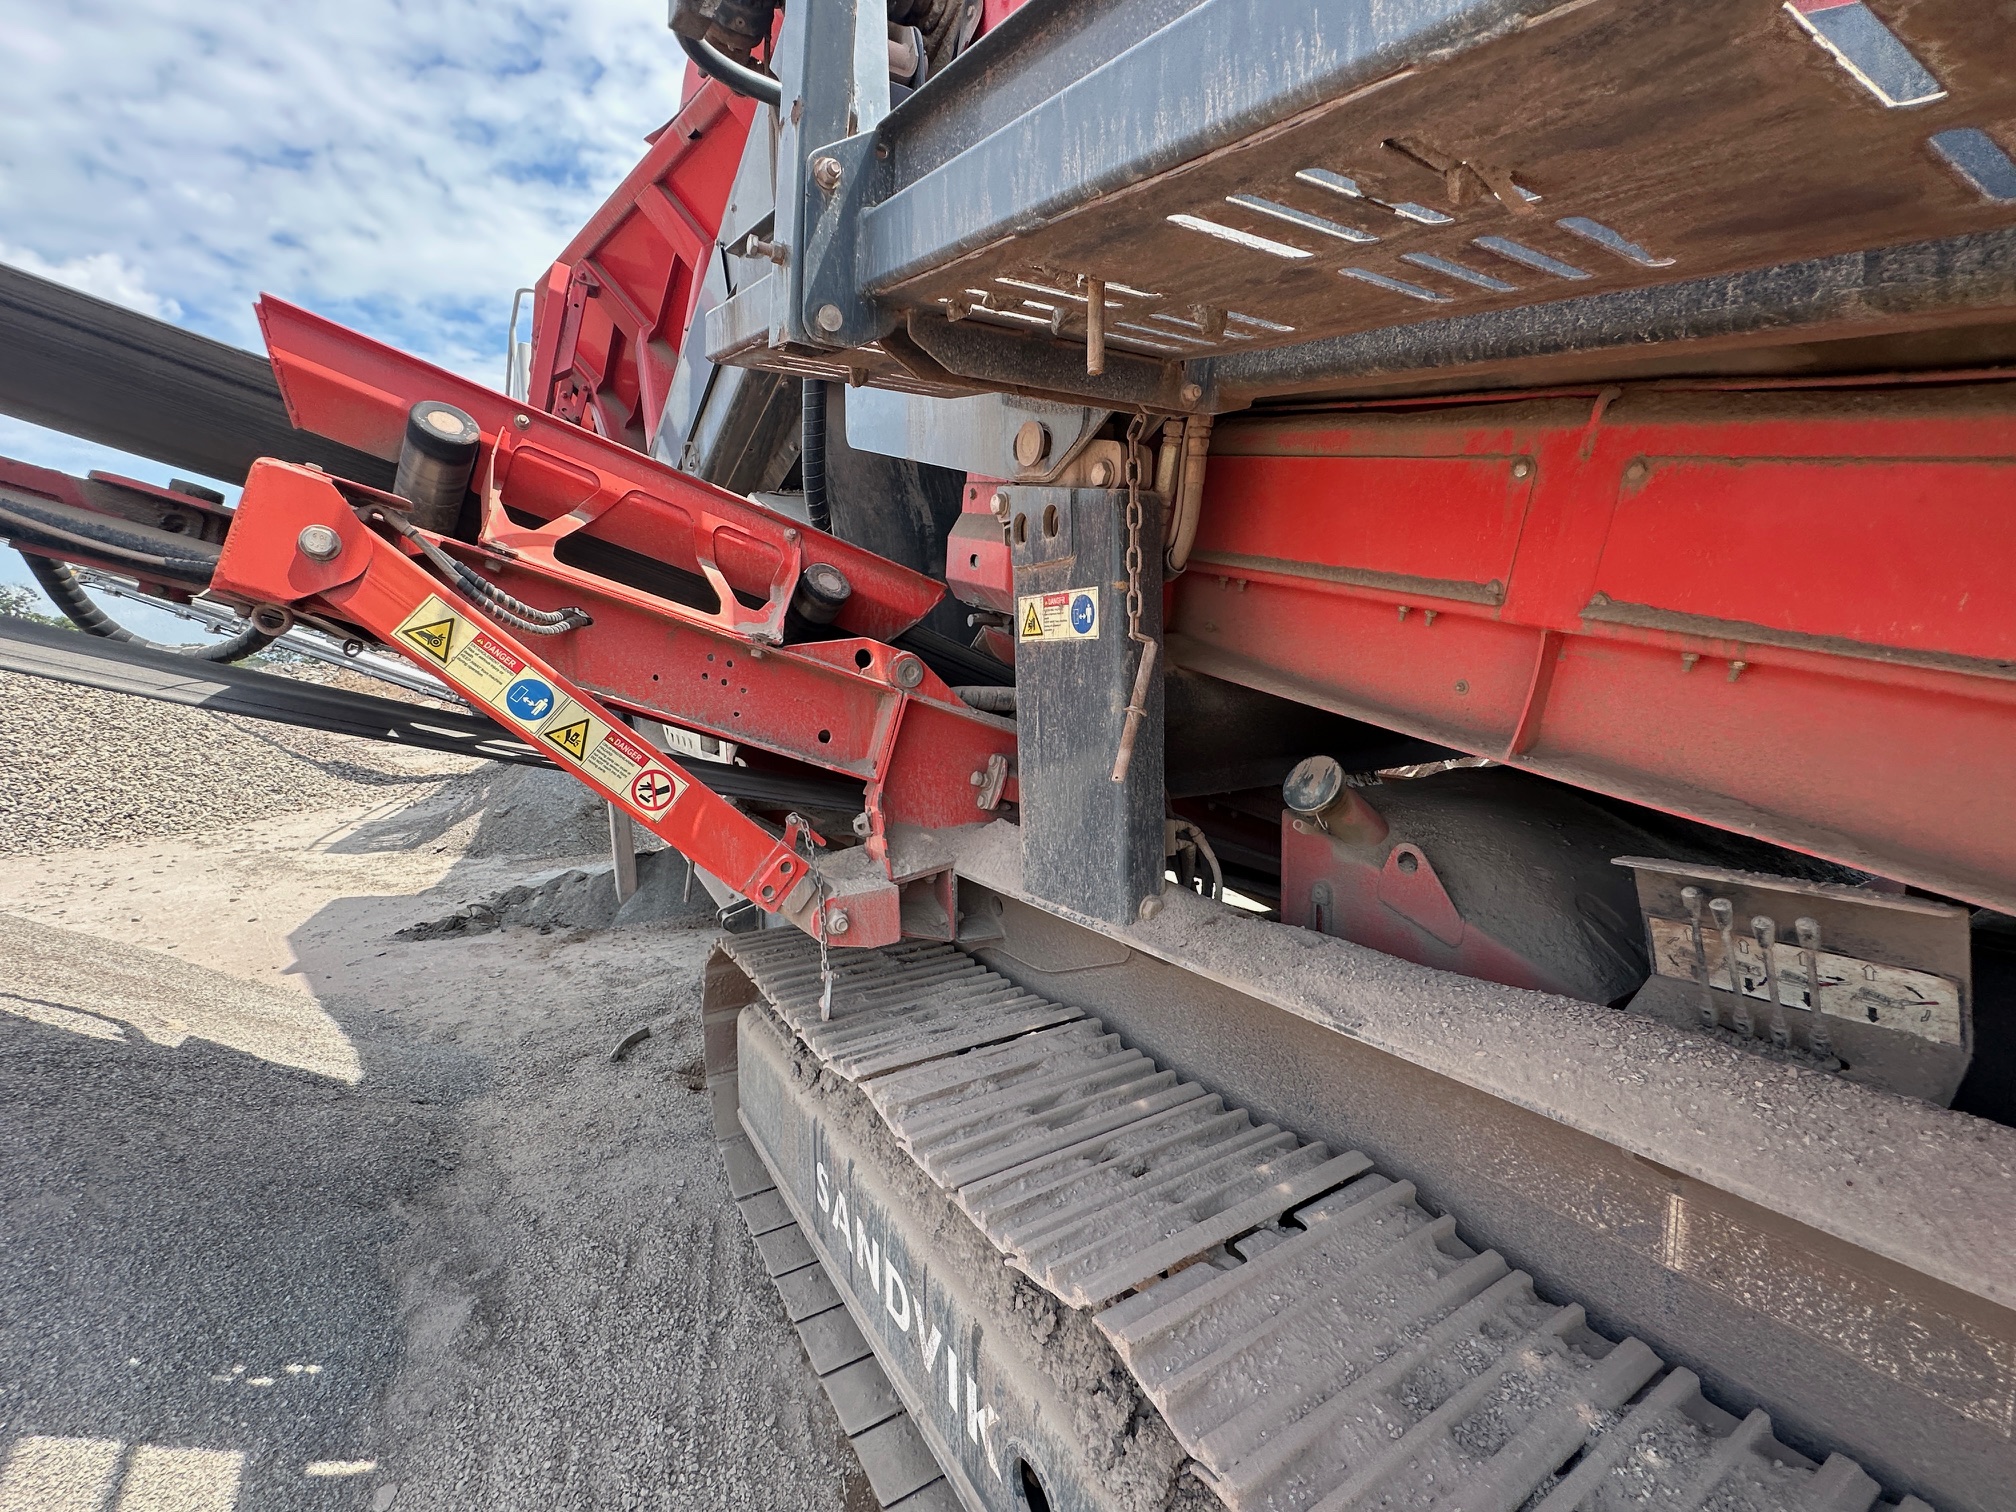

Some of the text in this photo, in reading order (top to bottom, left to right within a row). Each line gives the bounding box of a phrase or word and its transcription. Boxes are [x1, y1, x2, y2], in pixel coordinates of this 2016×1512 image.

[484, 641, 516, 668] DANGER
[614, 739, 642, 762] DANGER
[816, 1162, 1002, 1483] SANDVIK
